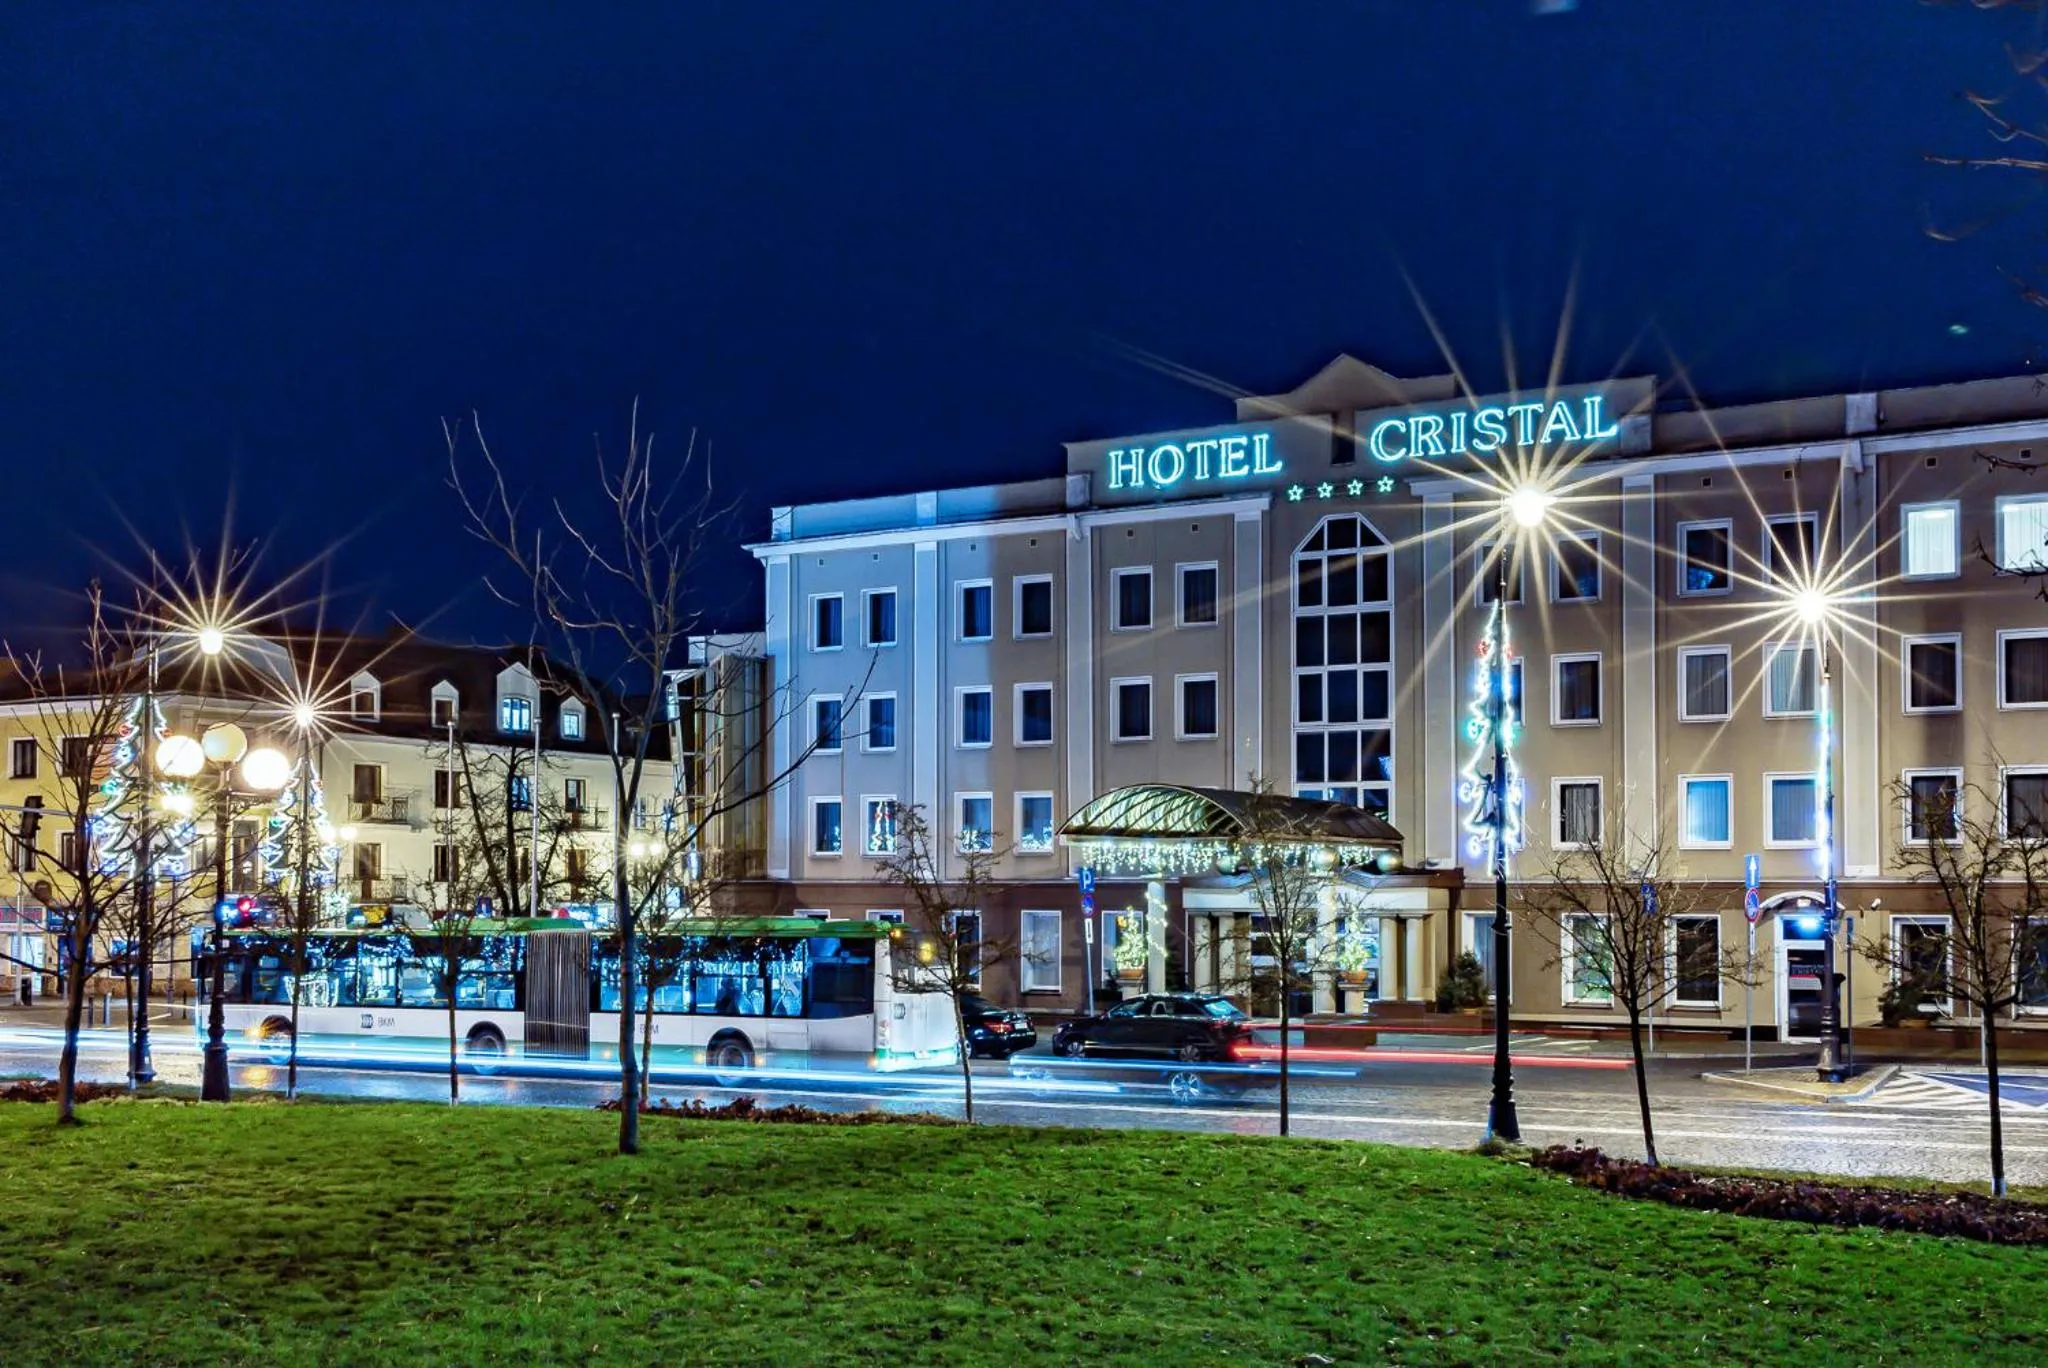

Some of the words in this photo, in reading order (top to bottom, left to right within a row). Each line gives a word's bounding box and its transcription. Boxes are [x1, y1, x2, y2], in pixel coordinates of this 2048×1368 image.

[1108, 433, 1283, 488] HOTEL
[1370, 396, 1618, 462] CRISTAL
[1082, 870, 1092, 889] P
